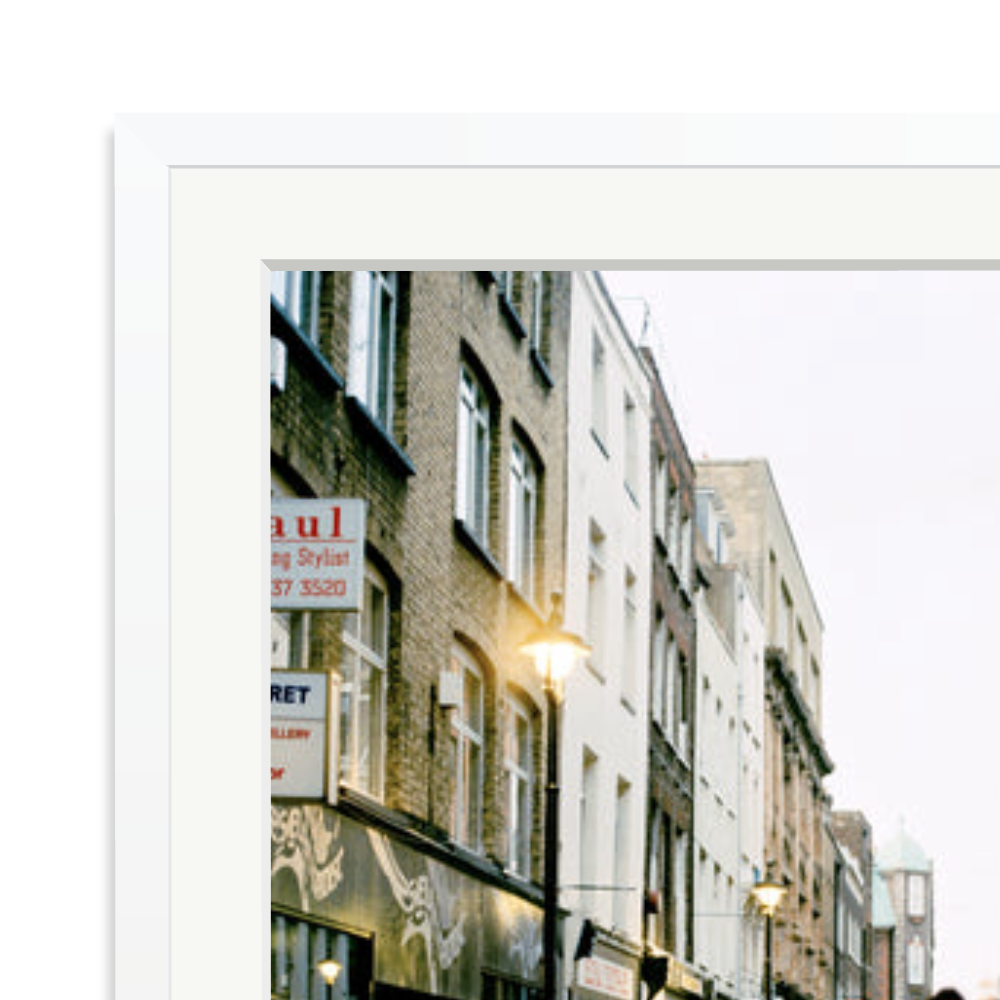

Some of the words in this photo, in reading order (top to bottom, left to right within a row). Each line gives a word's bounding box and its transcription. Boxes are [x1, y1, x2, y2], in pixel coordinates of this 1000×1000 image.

[297, 543, 350, 569] Stylist
[298, 577, 347, 597] 3520
[271, 683, 312, 704] RET
